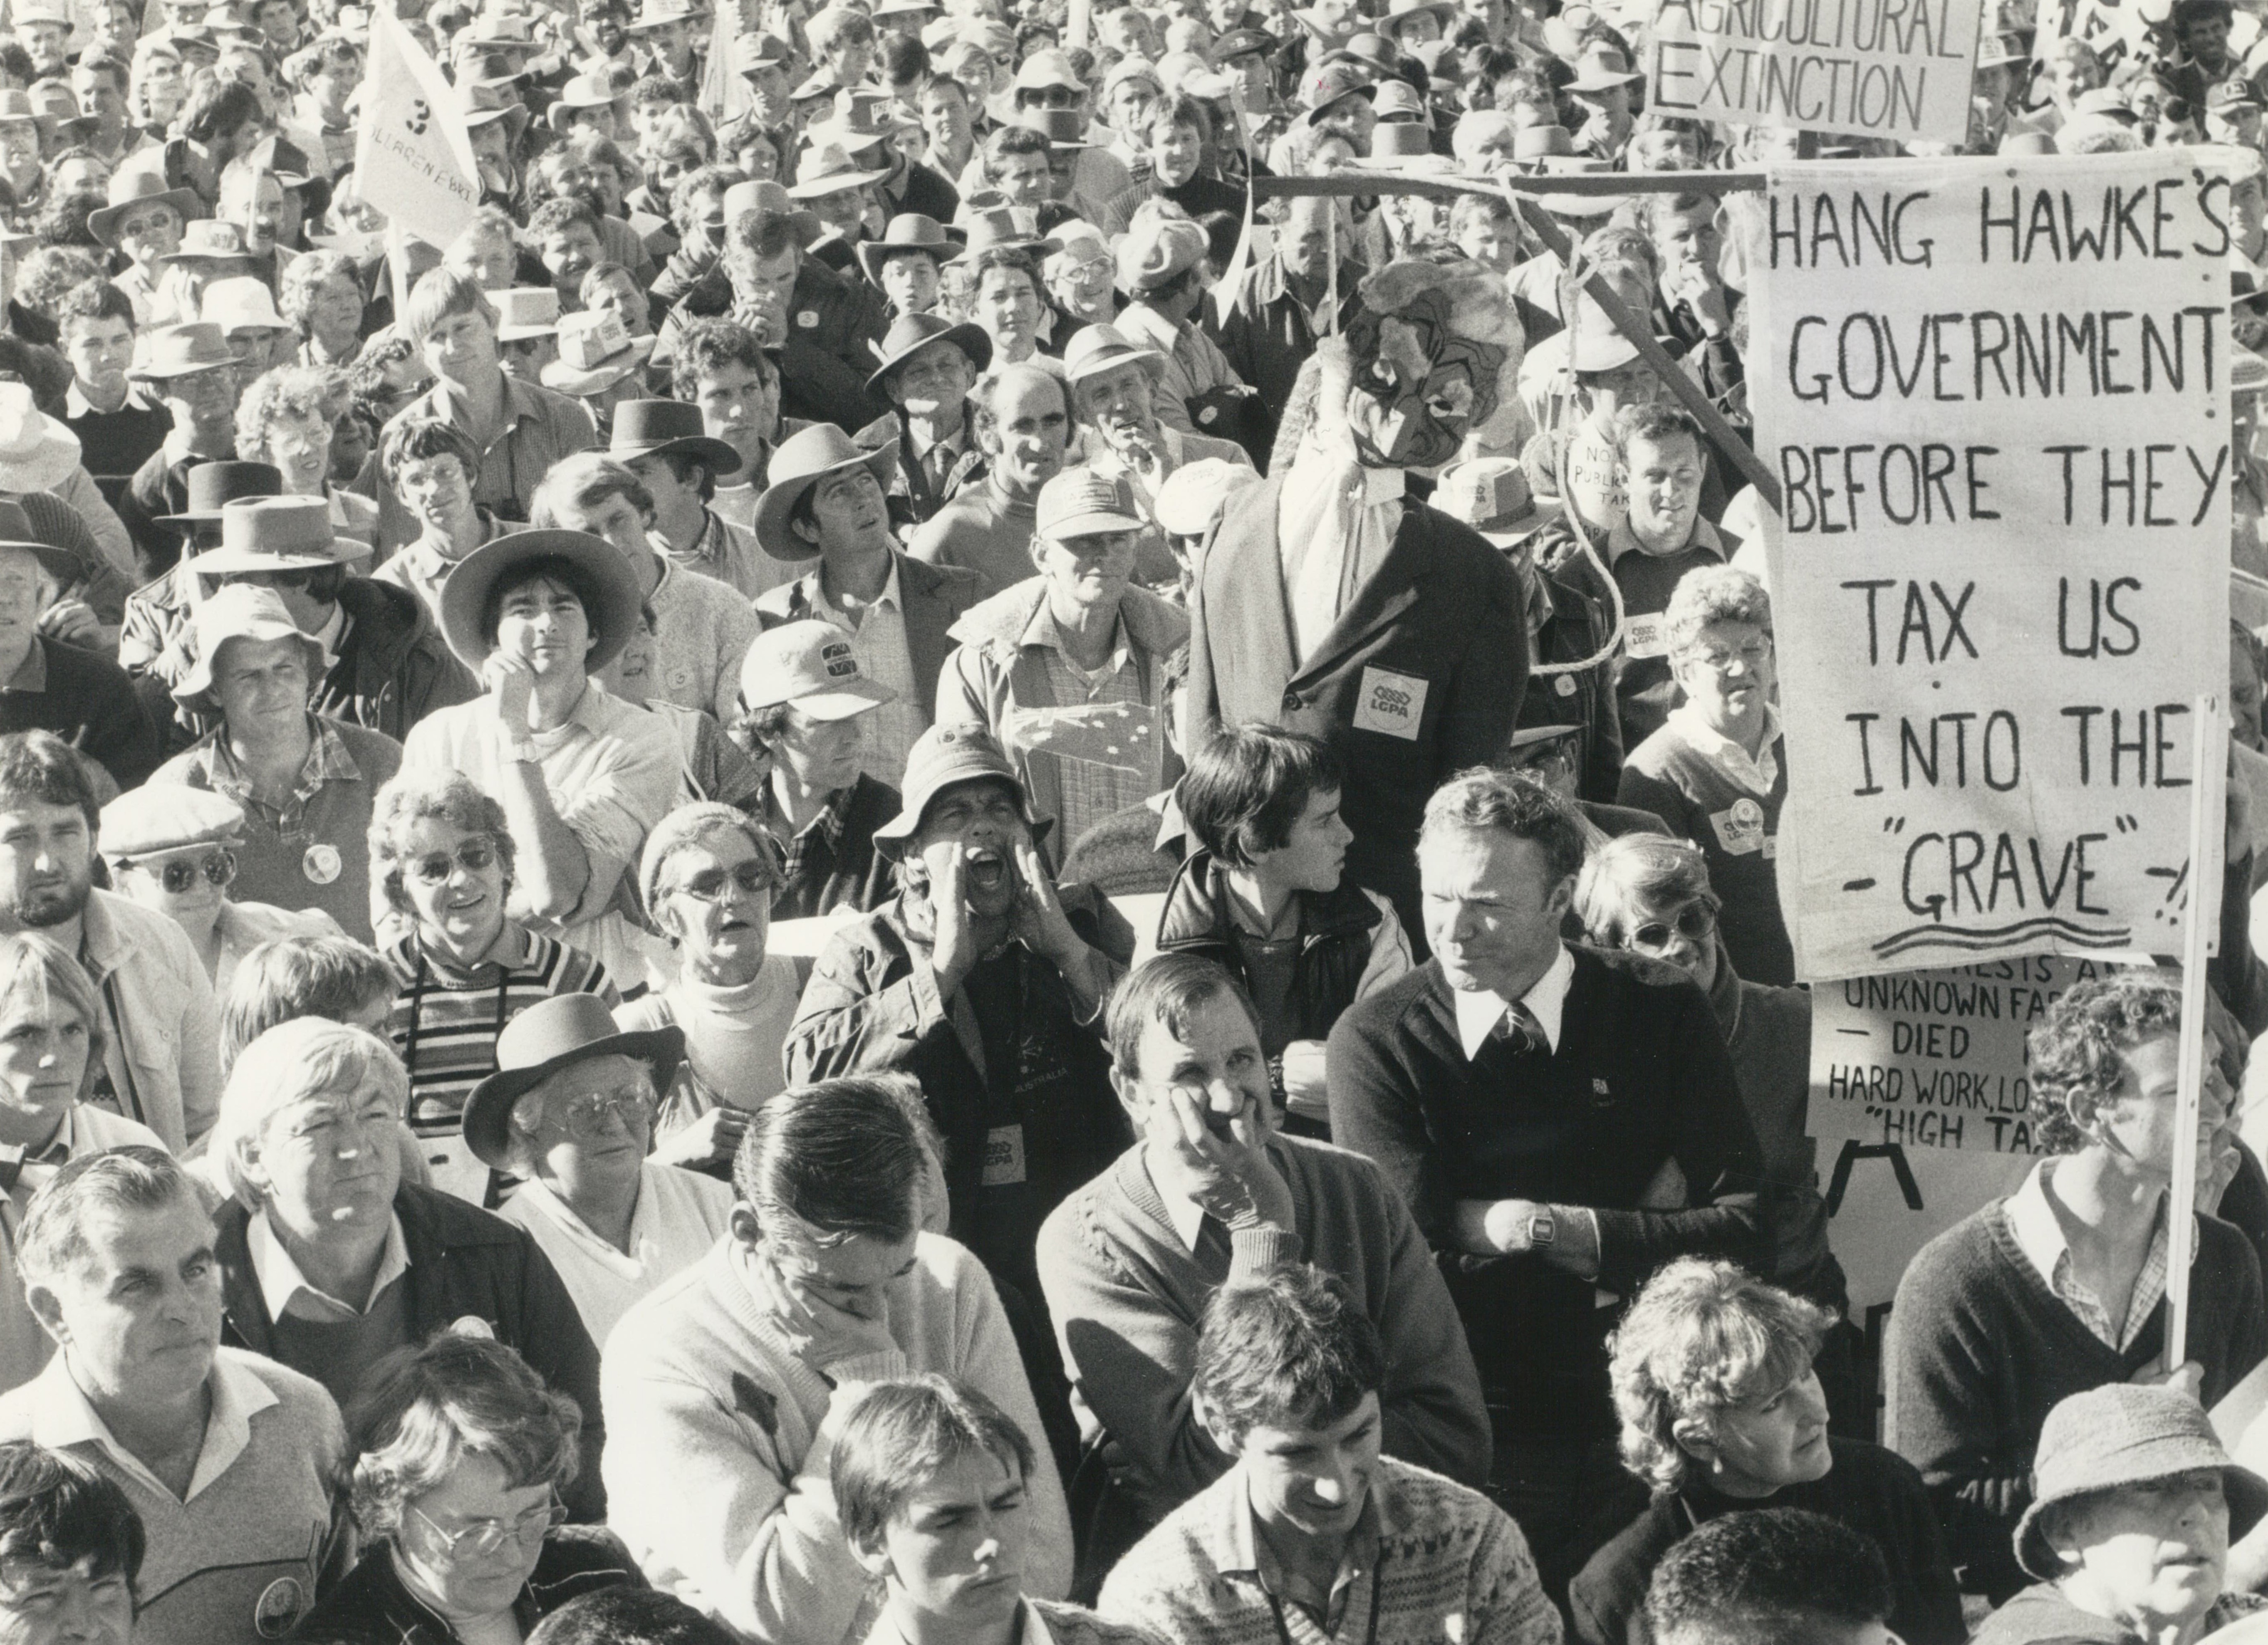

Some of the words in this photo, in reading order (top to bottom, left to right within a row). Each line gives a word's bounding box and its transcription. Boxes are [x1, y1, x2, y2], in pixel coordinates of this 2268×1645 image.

[1654, 40, 1926, 131] EXTINCTION
[1769, 190, 1934, 269] HANG
[1981, 168, 2230, 264] HAWKE'S
[1789, 306, 2226, 406] GOVERNMENT
[1780, 443, 2002, 534] BEFORE
[2041, 444, 2230, 527] THEY
[1839, 578, 1979, 666] TAX
[2057, 576, 2142, 660] US
[1370, 698, 1409, 718] LGPA
[1844, 709, 2022, 796] INTO
[2060, 703, 2193, 789] THE
[1845, 976, 2001, 1020] UNKNOWN
[1893, 1021, 1970, 1059] DIED
[1015, 1067, 1068, 1093] AUSTRALIA
[1830, 1064, 1903, 1103] HARD
